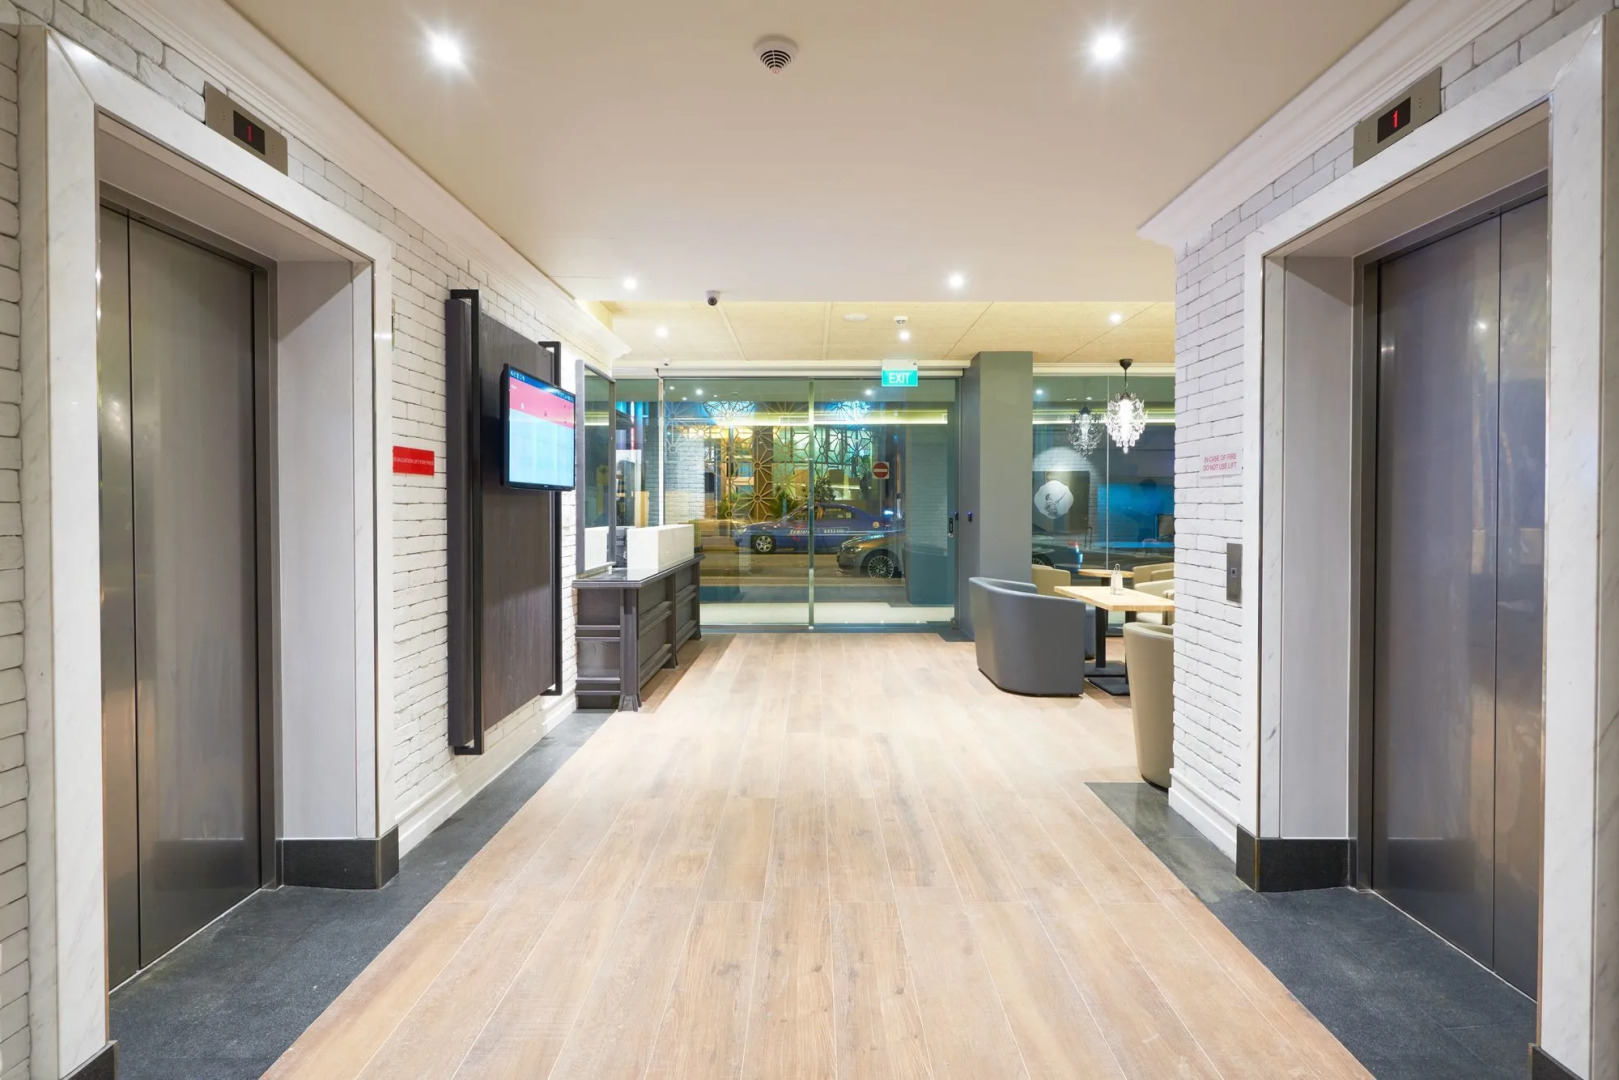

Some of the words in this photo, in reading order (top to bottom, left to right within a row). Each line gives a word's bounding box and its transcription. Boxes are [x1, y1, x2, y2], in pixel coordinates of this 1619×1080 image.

[1393, 110, 1398, 128] 1
[247, 123, 252, 142] 1
[889, 372, 909, 384] EXIT
[1209, 463, 1219, 471] NOT
[1219, 462, 1227, 470] USE
